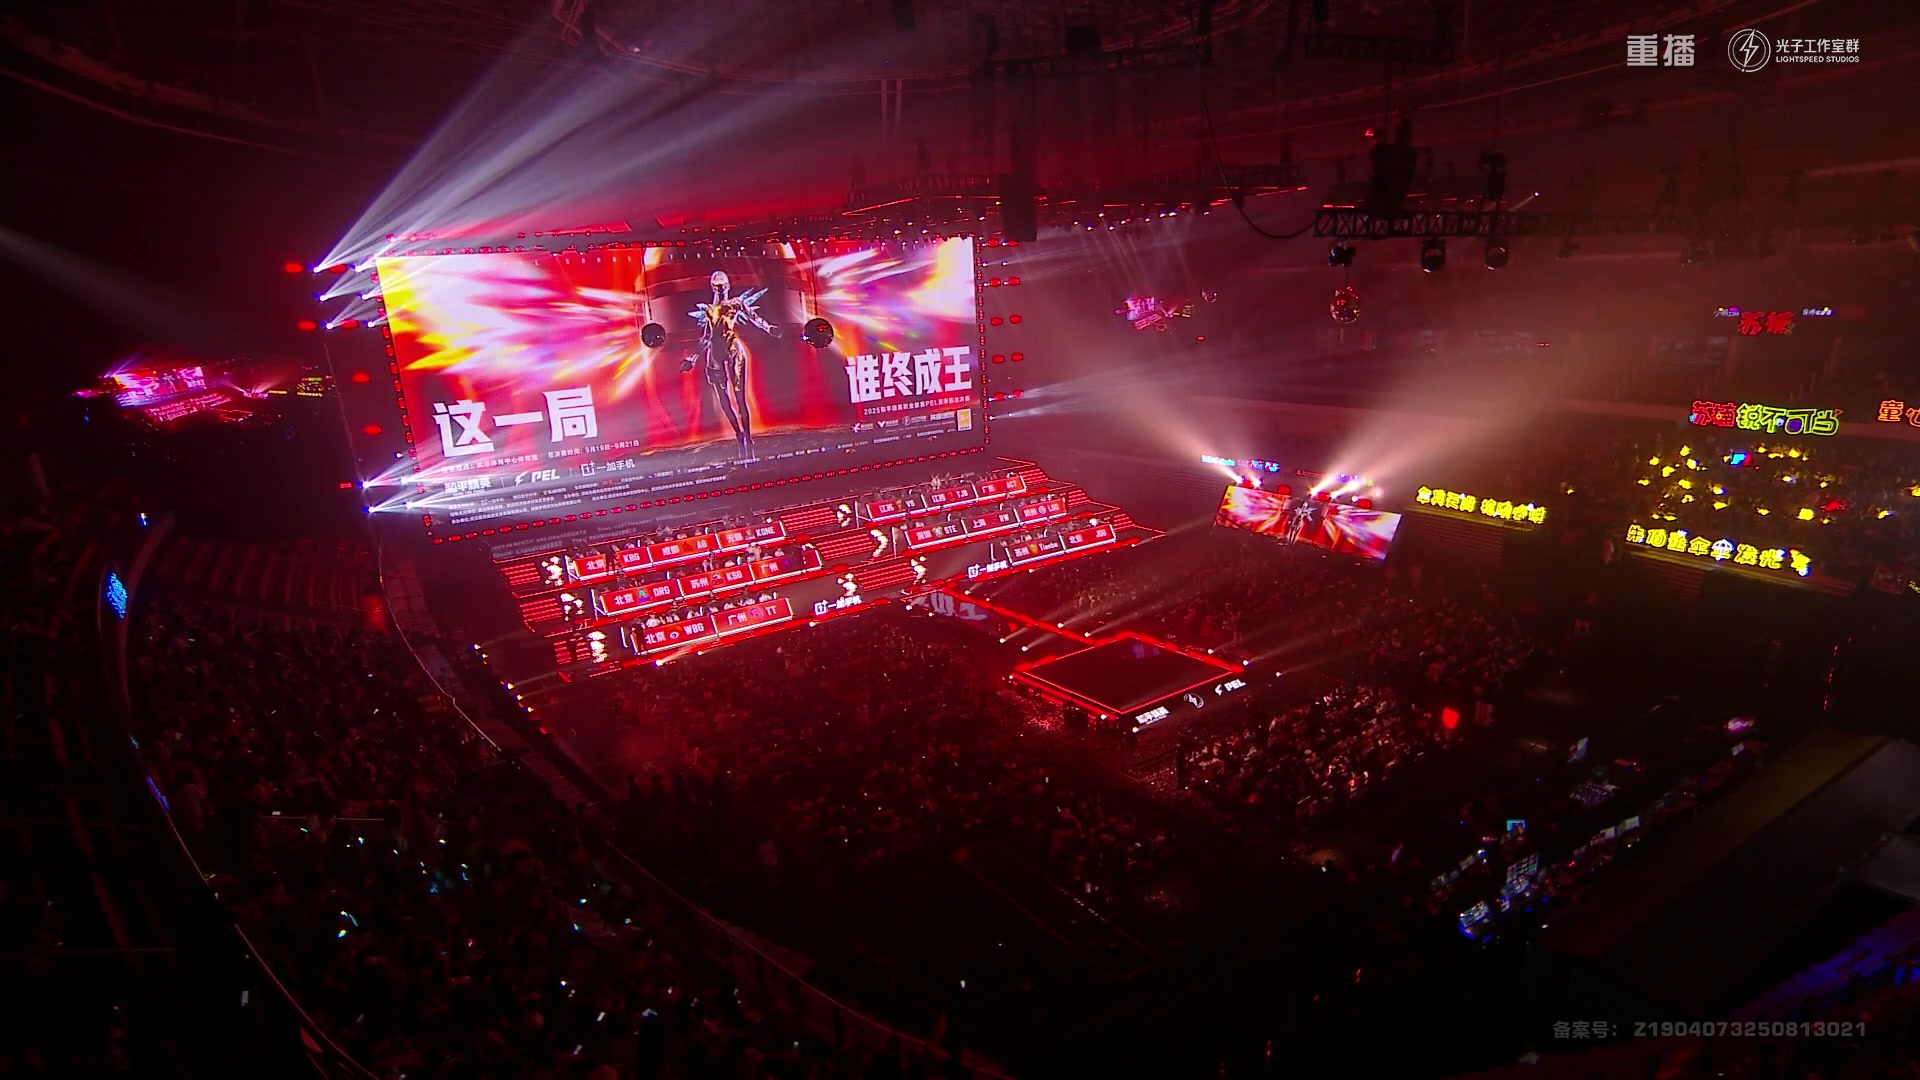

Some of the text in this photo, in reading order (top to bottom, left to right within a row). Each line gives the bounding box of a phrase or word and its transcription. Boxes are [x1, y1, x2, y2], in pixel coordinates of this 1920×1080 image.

[845, 346, 972, 403] 谁终成王
[432, 385, 598, 457] 这一局
[596, 458, 636, 472] 一加手机
[531, 469, 561, 483] PEL
[755, 526, 776, 537] KONE
[943, 525, 958, 535] STE
[696, 540, 708, 550] AG
[586, 559, 606, 571] 北京
[760, 562, 779, 575] 广州
[725, 570, 743, 581] KSG
[614, 586, 671, 606] 北京 DRG
[727, 605, 777, 626] 广州 TT
[645, 623, 705, 645] 北京 WBG
